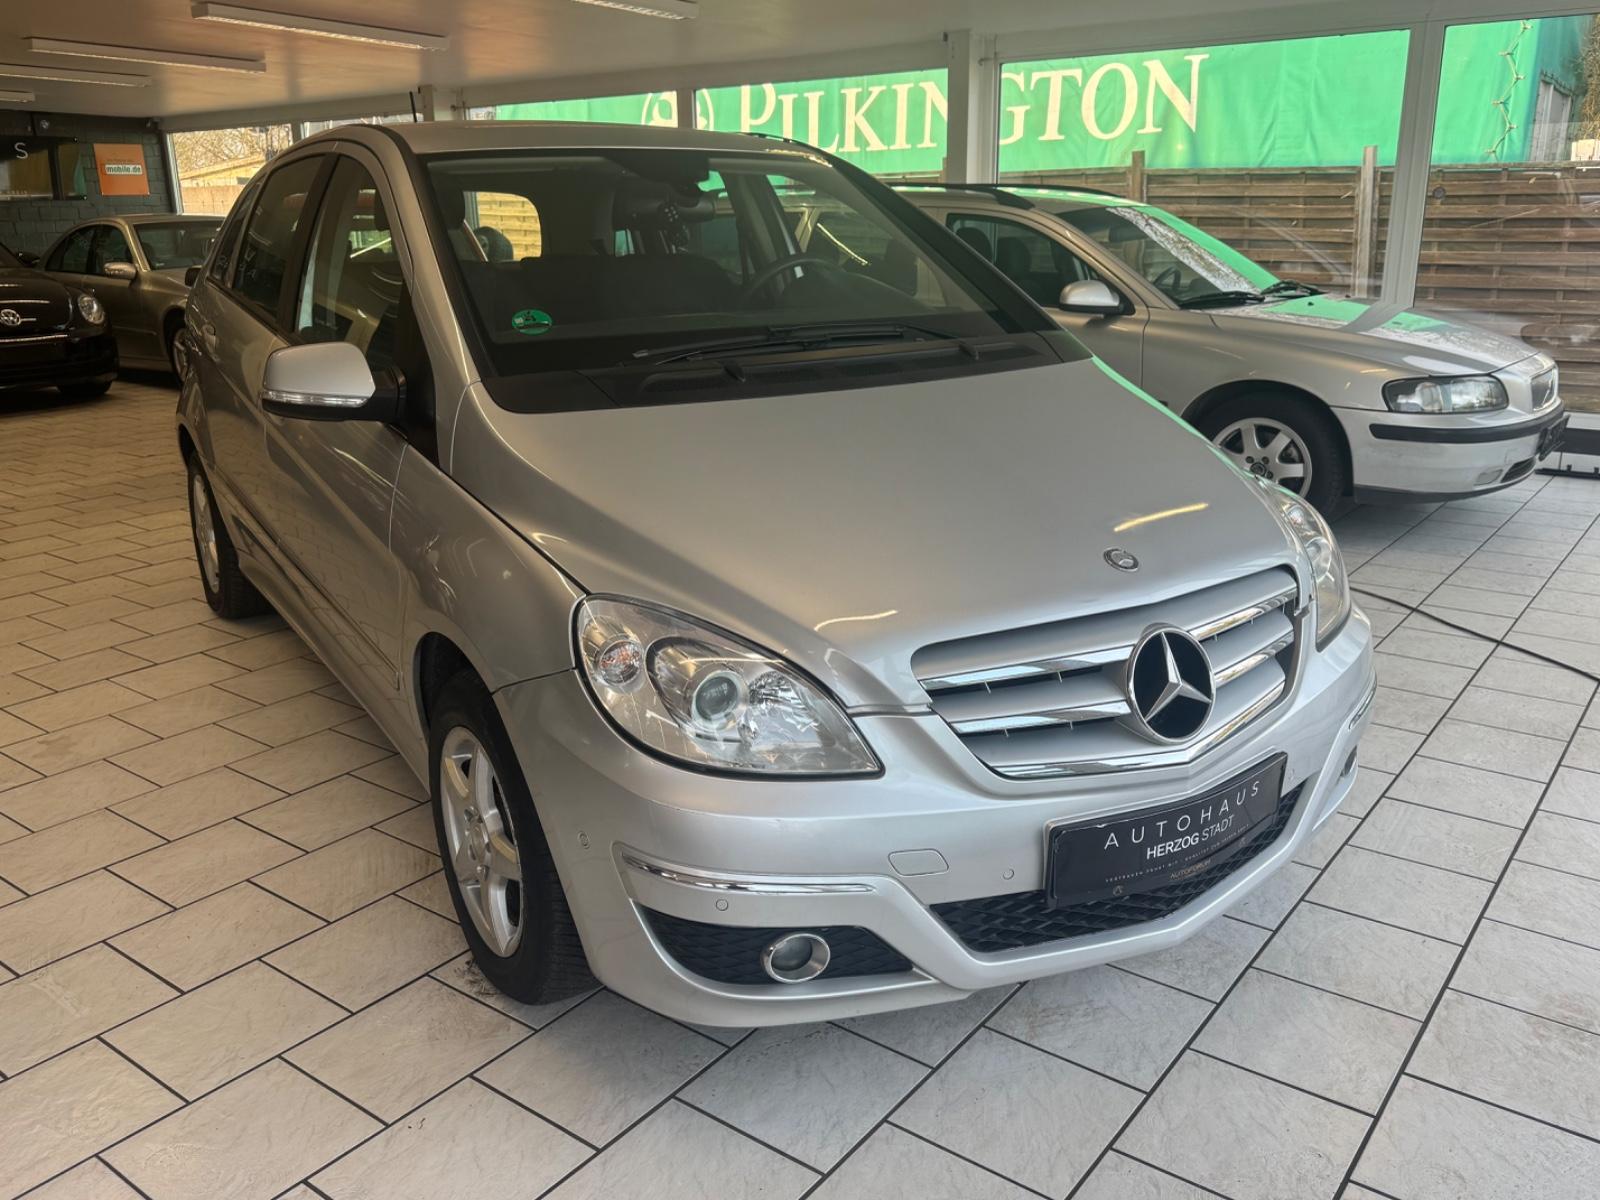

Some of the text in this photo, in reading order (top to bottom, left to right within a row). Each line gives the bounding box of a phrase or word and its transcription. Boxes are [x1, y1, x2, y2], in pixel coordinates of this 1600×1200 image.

[1104, 780, 1260, 850] AUTOHAUS
[1146, 832, 1200, 860] HERZOG
[1201, 814, 1235, 841] STADT
